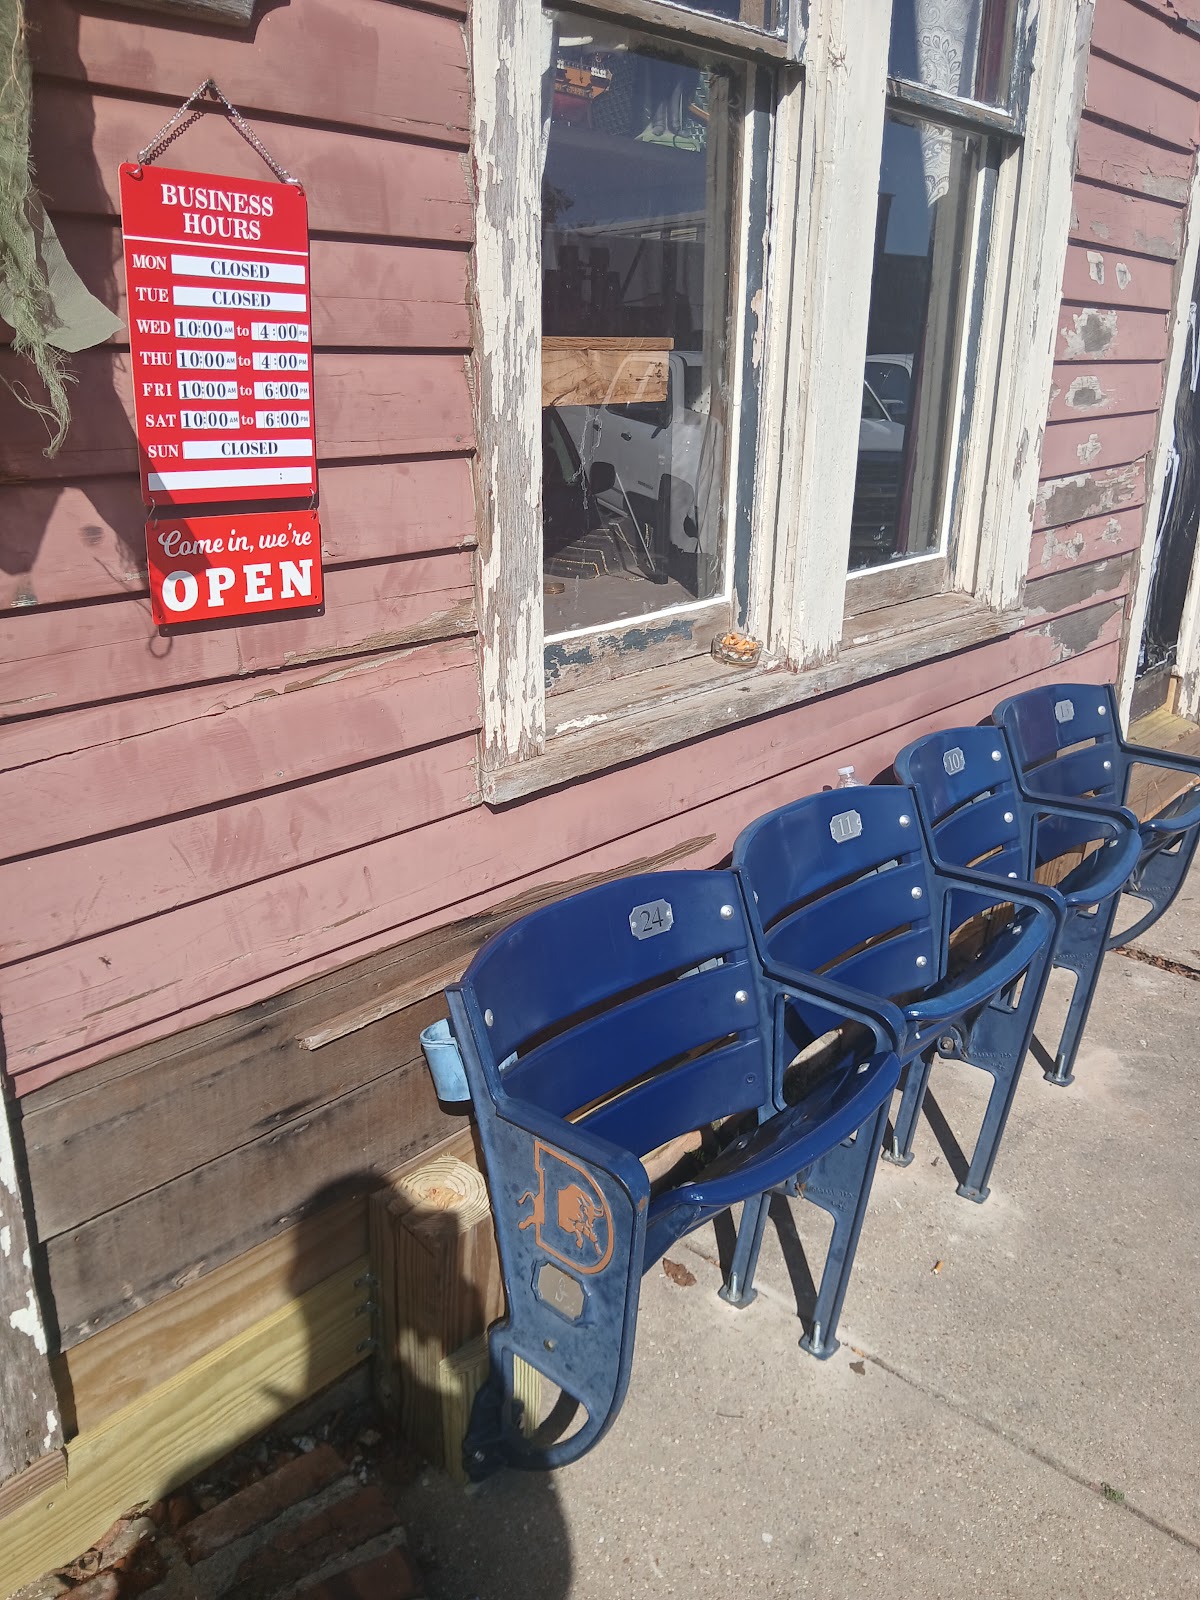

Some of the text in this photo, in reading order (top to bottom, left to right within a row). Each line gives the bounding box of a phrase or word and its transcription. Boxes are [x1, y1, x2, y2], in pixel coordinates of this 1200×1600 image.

[161, 183, 274, 218] BUSINESS
[183, 212, 262, 241] HOURS
[132, 254, 270, 279] MON CLOSED
[135, 287, 271, 308] TUE CLOSED
[136, 319, 171, 335] WED
[237, 326, 250, 337] to
[140, 351, 172, 366] THU
[238, 355, 251, 367] to
[142, 383, 173, 397] FRI
[239, 384, 253, 396] to
[145, 414, 177, 428] SAT
[241, 414, 254, 426] to
[148, 441, 278, 459] SUN CLOSED
[158, 523, 313, 558] Come in, we're
[162, 558, 313, 613] OPEN
[947, 752, 960, 772] 10
[838, 815, 853, 837] 11
[639, 906, 664, 933] 24
